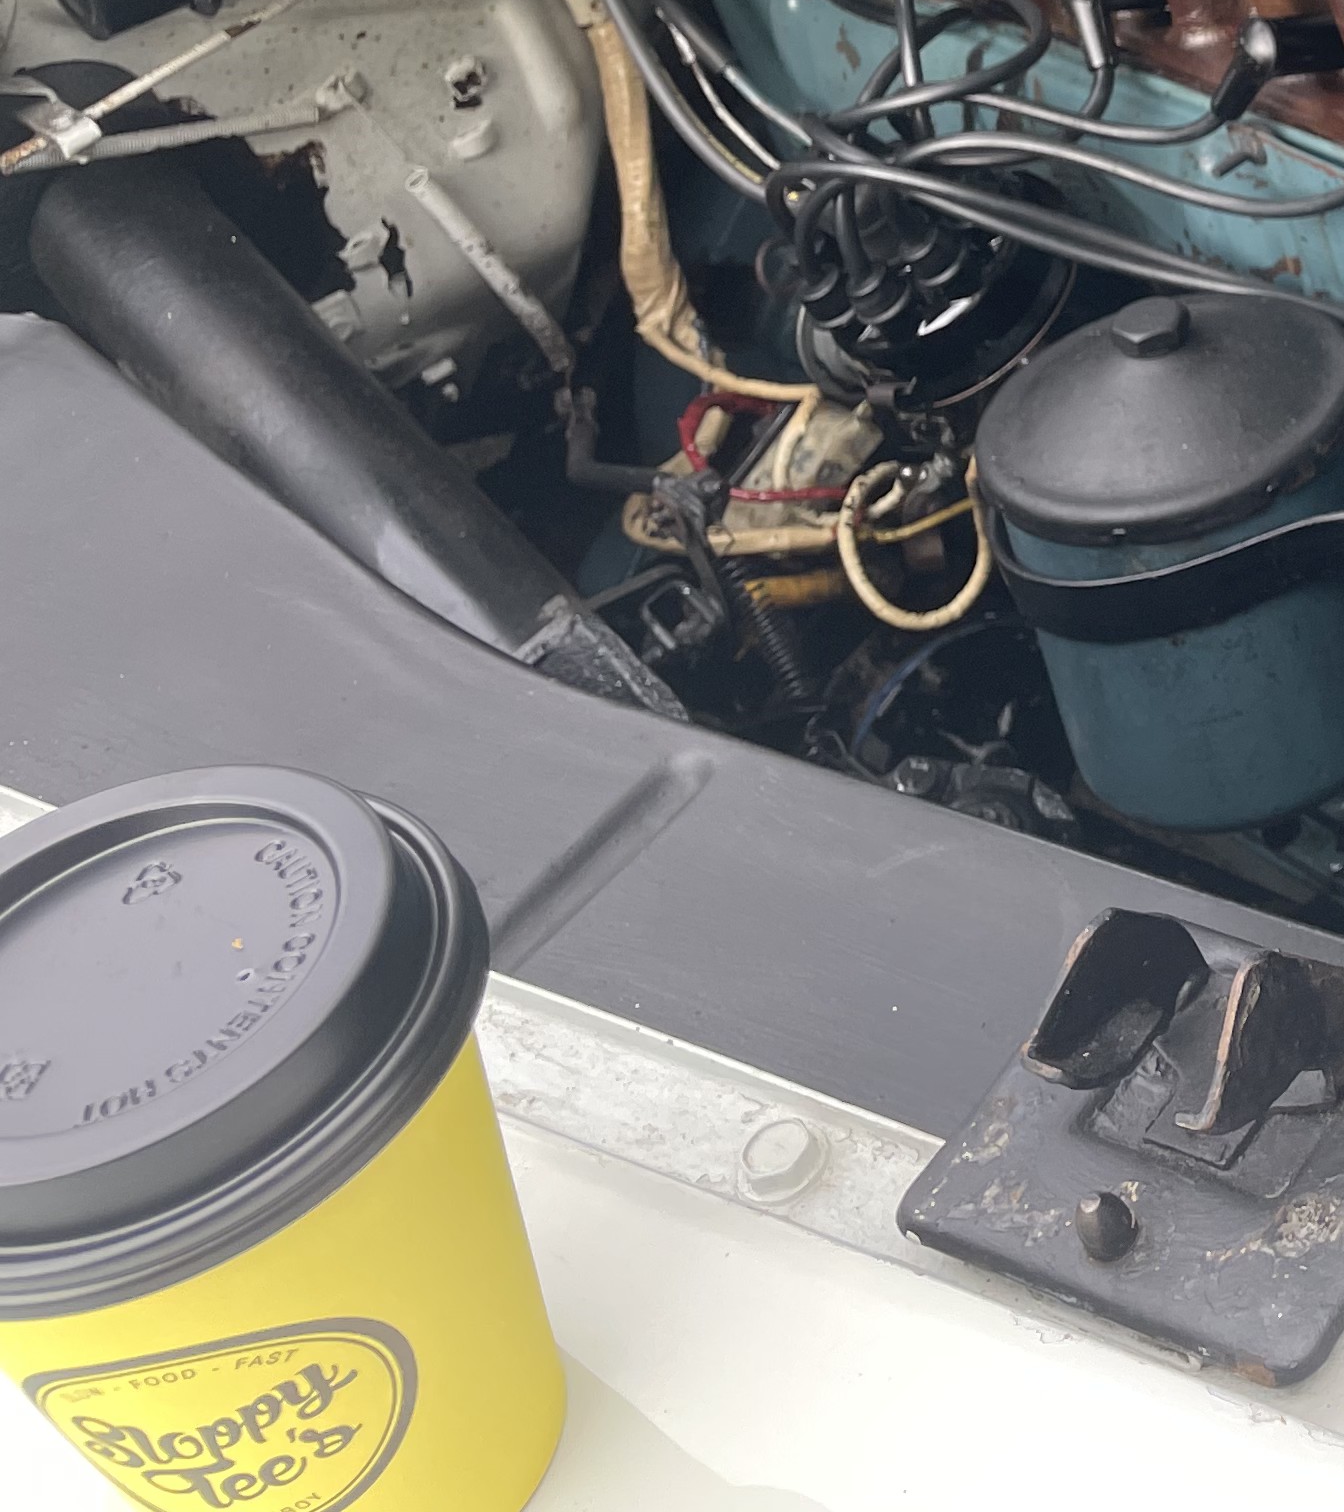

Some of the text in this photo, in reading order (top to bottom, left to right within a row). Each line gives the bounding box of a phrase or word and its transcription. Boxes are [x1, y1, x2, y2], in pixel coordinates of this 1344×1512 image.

[73, 840, 324, 1129] CAUTION CONTENTS HOT
[71, 1363, 359, 1468] Sloppy
[129, 1348, 300, 1389] FOOD FAST
[141, 1422, 364, 1509] Tee's
